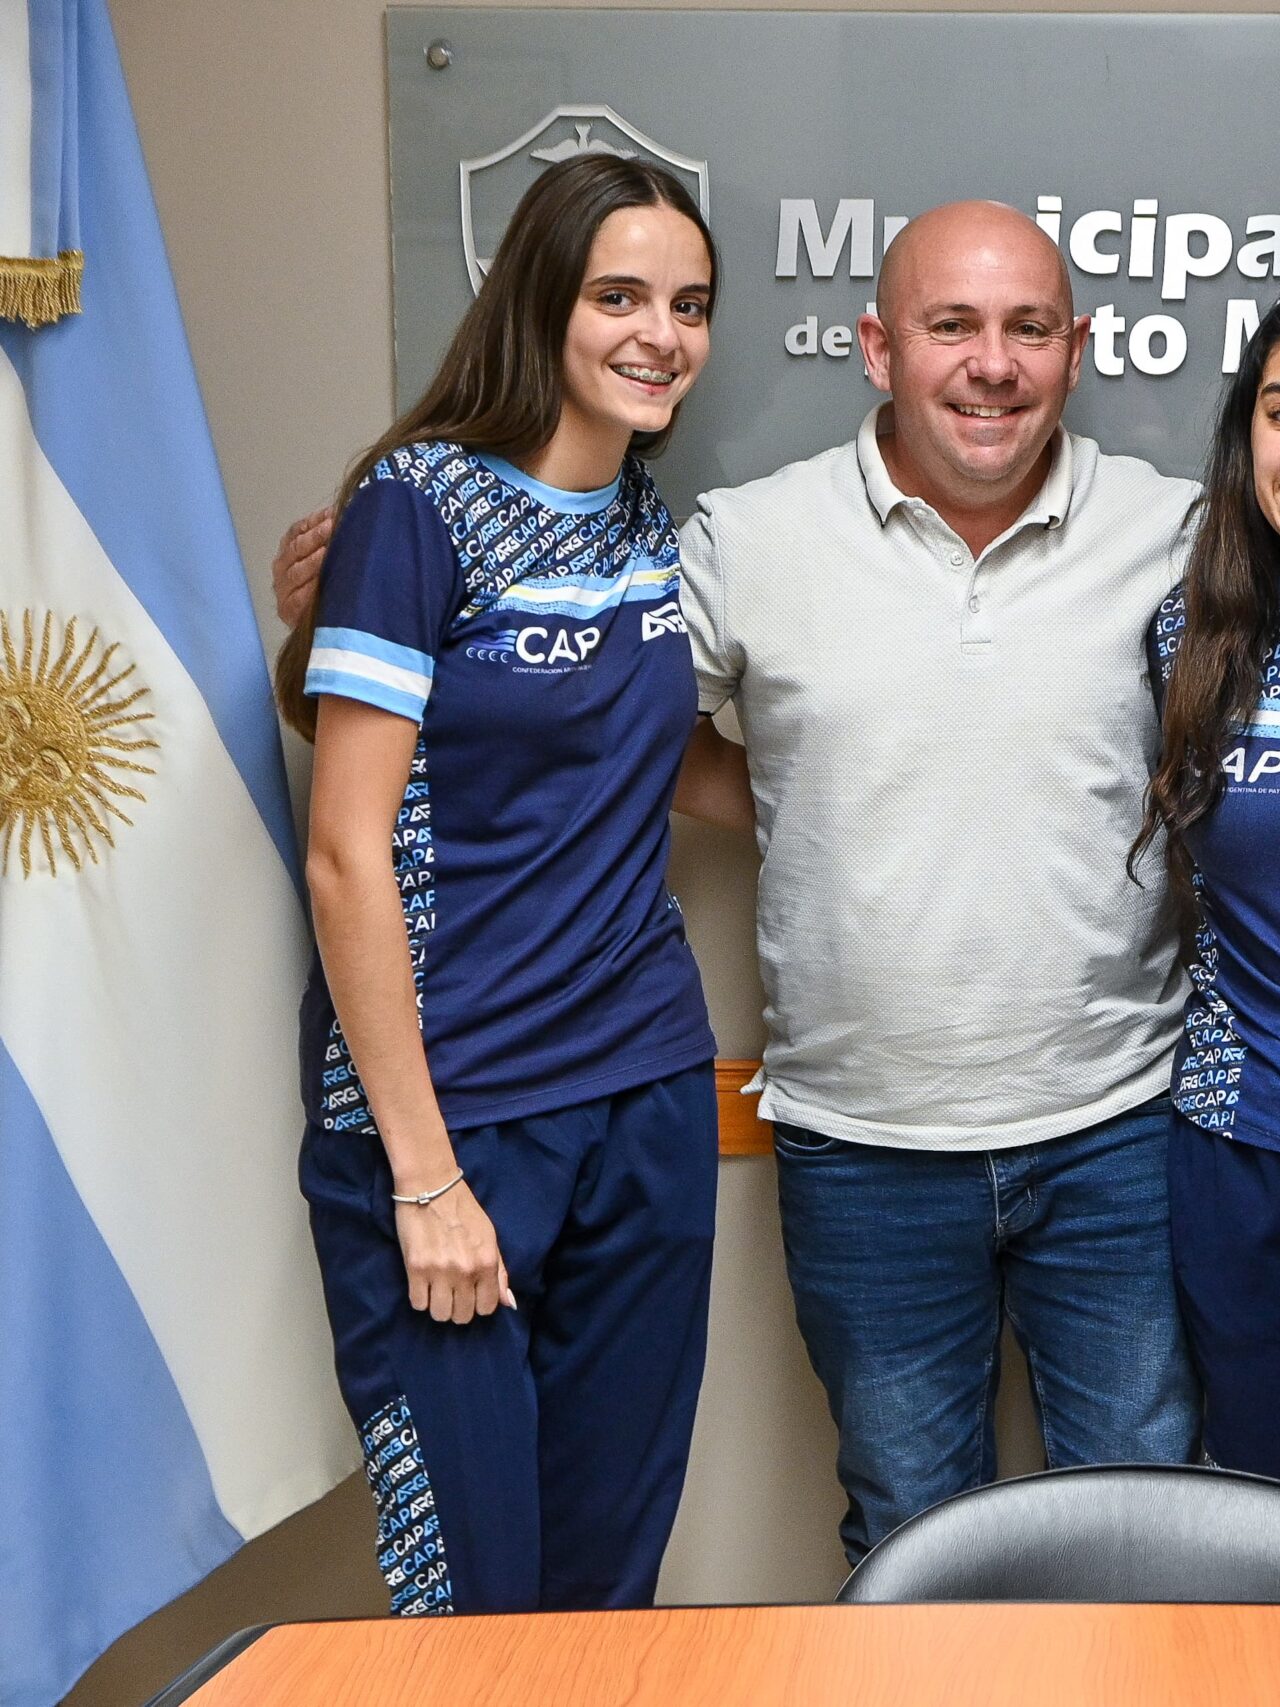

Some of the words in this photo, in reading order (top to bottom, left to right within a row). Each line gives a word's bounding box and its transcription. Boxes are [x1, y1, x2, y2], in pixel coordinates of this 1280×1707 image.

[784, 315, 853, 358] de
[1160, 598, 1186, 614] CA
[641, 602, 688, 641] AR
[1162, 615, 1186, 633] CA
[515, 626, 601, 665] CAP
[394, 848, 425, 872] AP
[395, 870, 431, 891] AP
